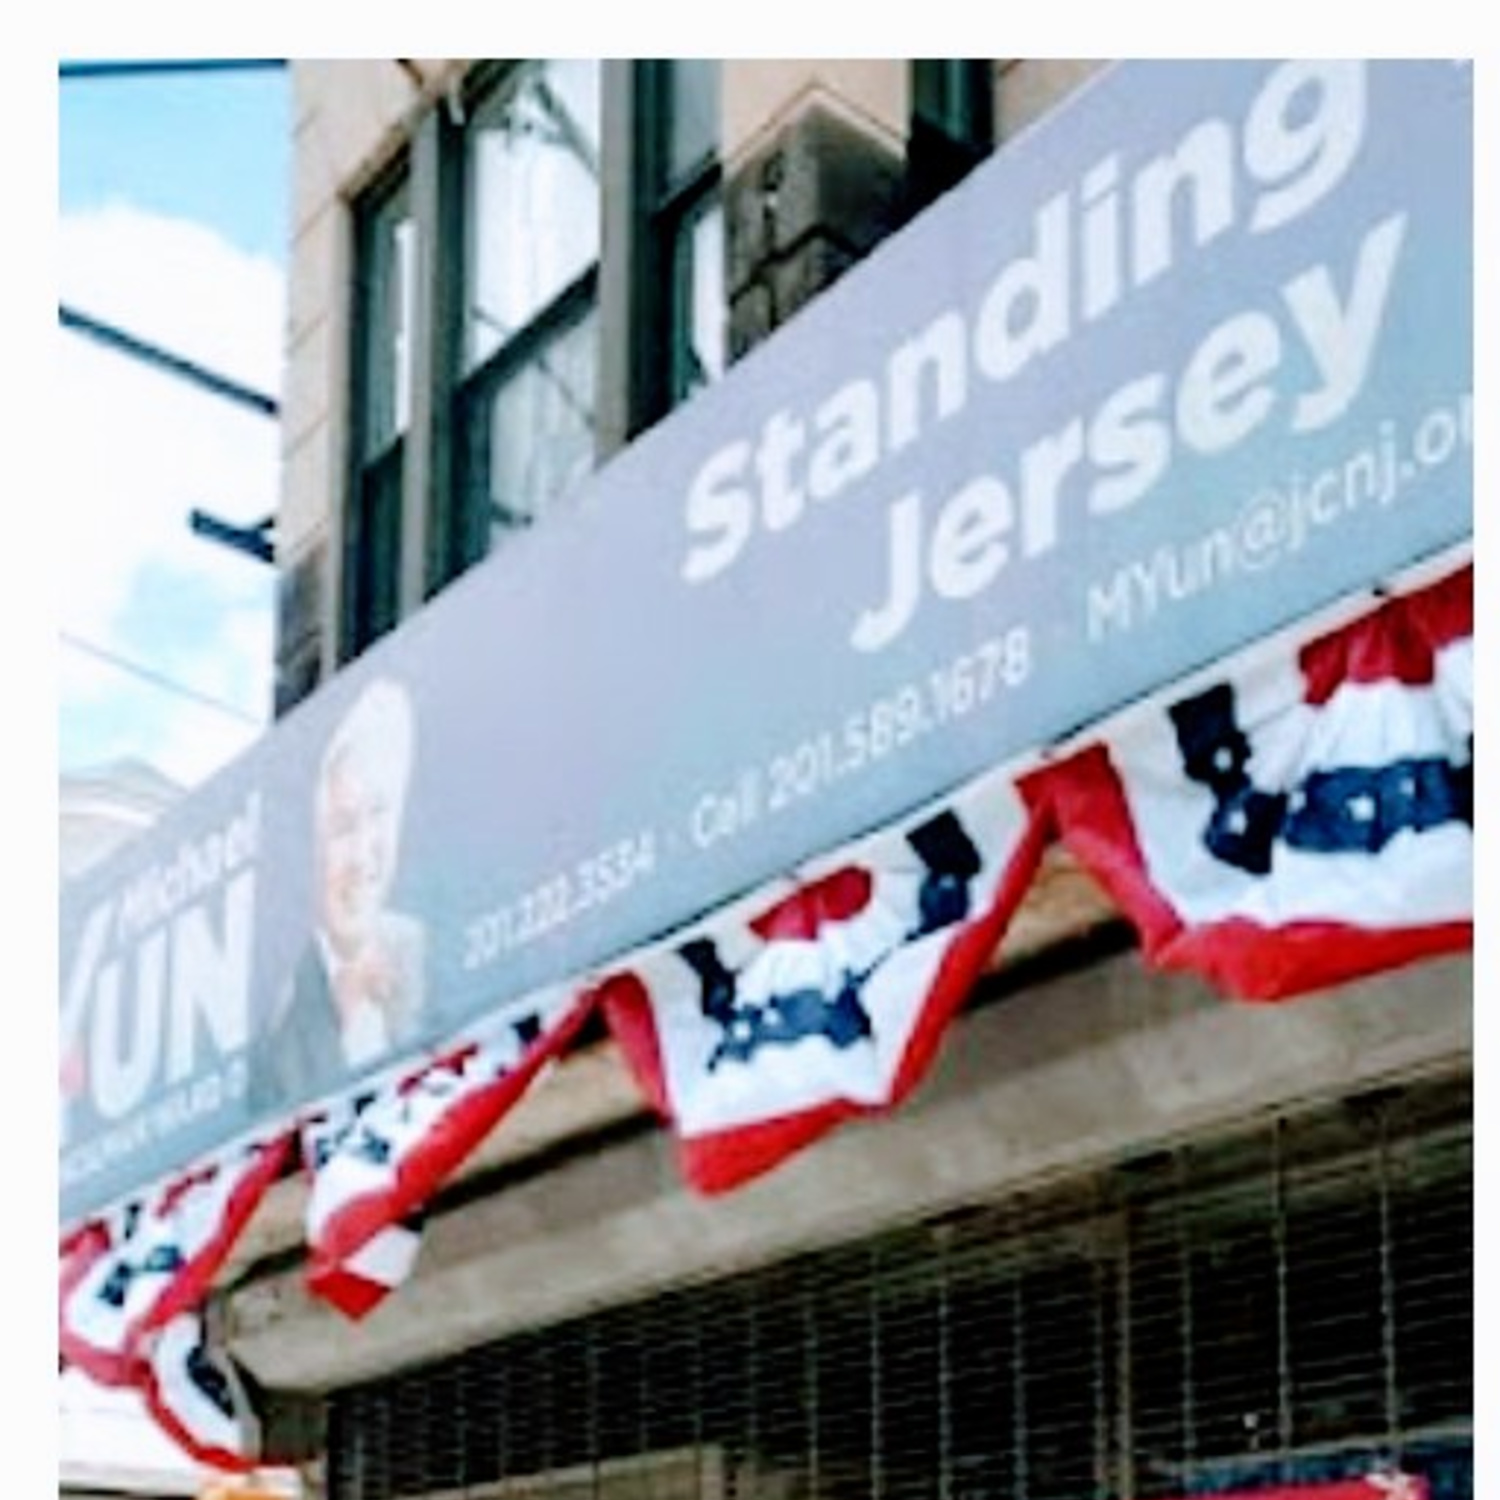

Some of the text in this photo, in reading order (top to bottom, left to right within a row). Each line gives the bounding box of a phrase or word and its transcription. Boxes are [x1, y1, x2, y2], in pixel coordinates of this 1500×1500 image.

[681, 58, 1368, 584] Standing
[849, 212, 1408, 654] Jersey
[767, 625, 1032, 810] 201.589.1678
